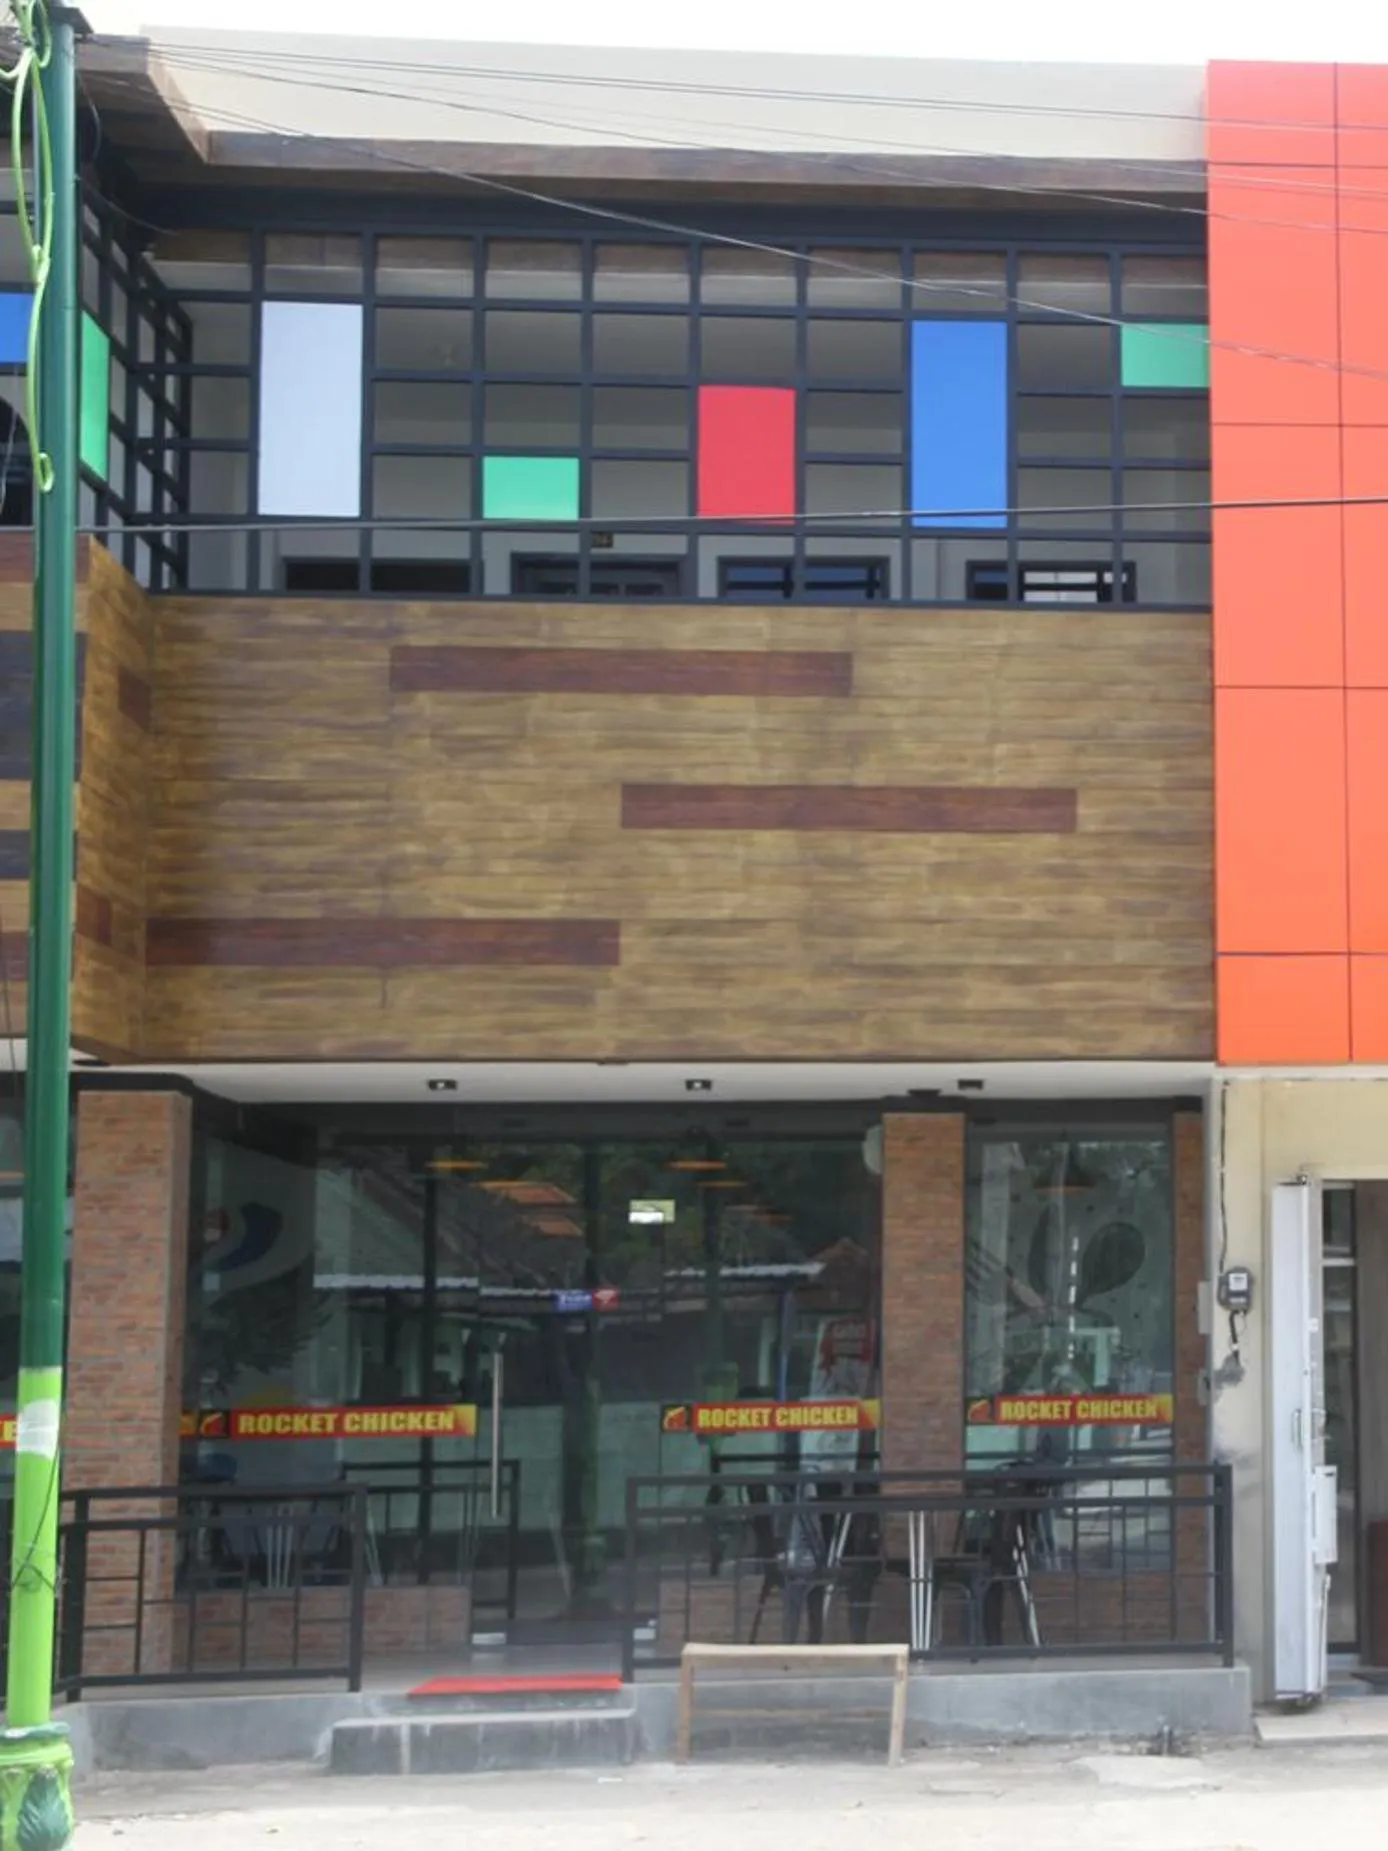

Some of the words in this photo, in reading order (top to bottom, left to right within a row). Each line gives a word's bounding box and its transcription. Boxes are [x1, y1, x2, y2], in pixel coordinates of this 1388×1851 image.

[697, 1407, 772, 1428] ROCKET
[776, 1405, 859, 1426] CHICKEN
[1001, 1401, 1073, 1421] ROCKET
[1077, 1399, 1158, 1419] CHICKEN
[238, 1413, 338, 1434] ROCKET
[343, 1410, 455, 1432] CHICKEN
